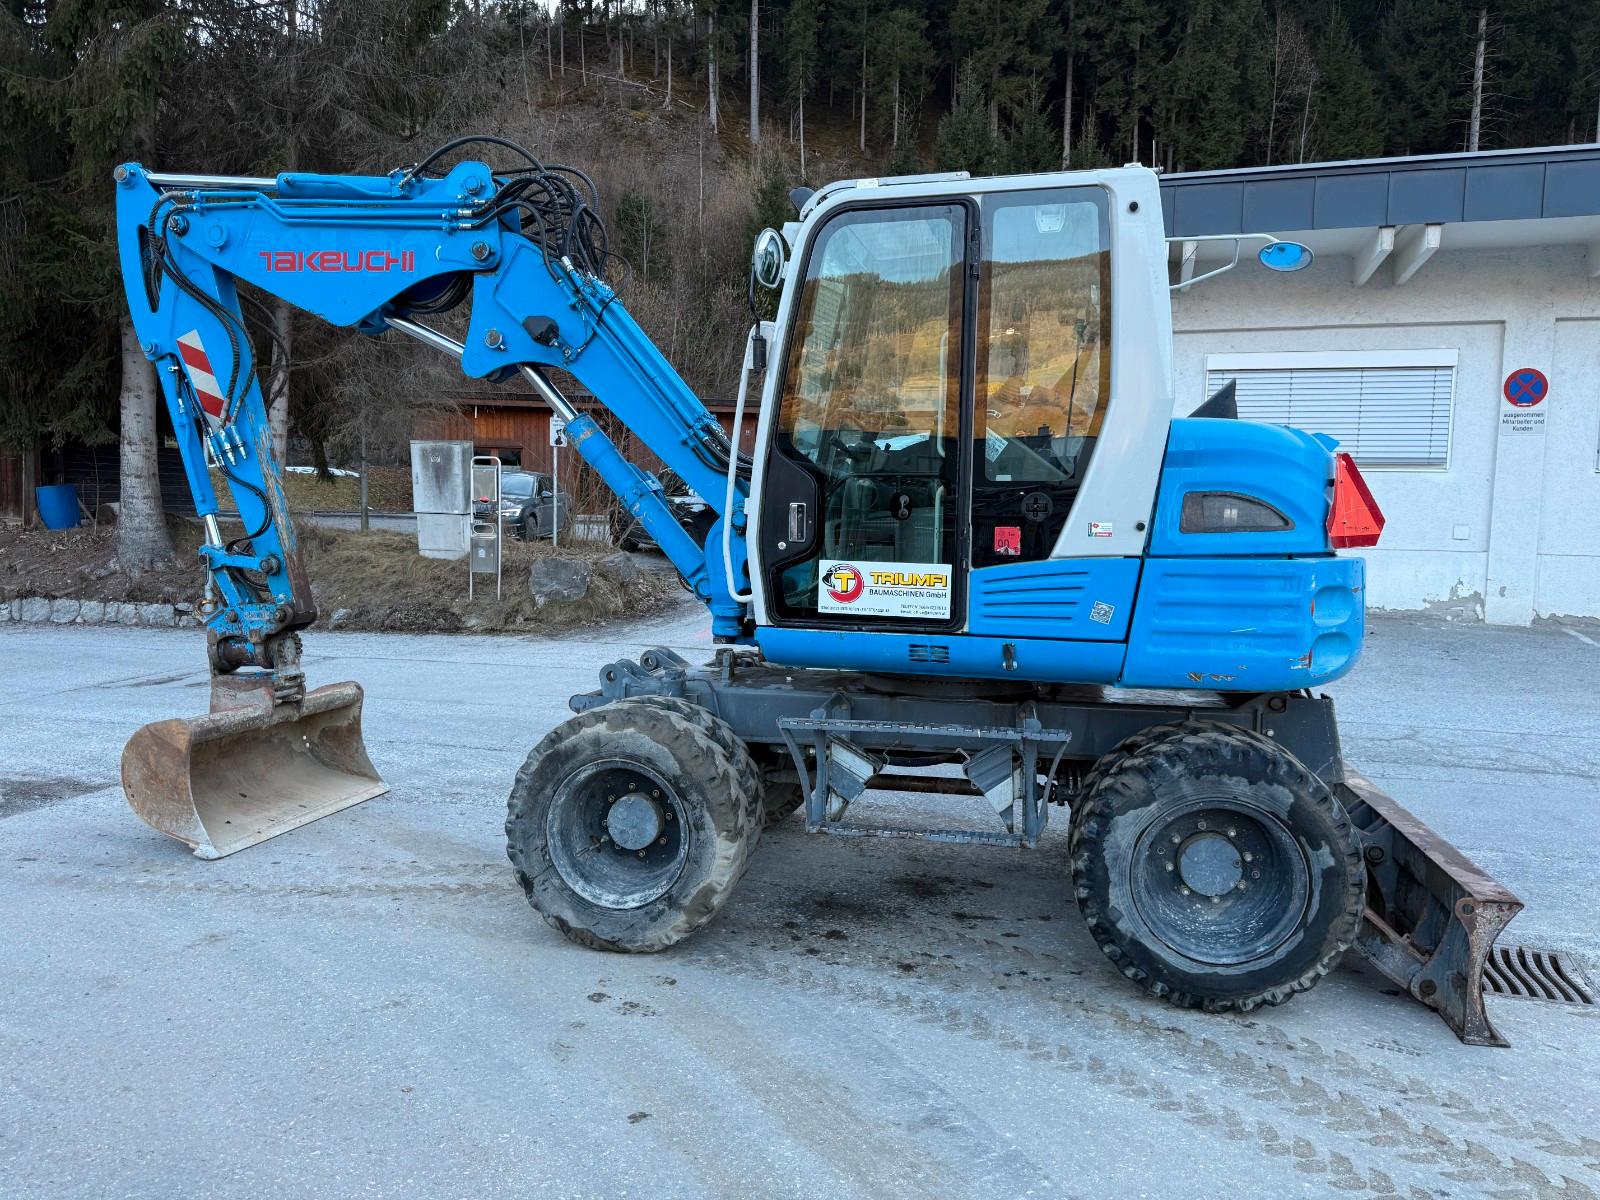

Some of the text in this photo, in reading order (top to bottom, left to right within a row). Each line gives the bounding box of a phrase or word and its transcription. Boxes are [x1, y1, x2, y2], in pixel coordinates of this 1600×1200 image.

[870, 571, 948, 587] TRIUMFI
[869, 588, 947, 599] BAUMASCHINEN GmbH
